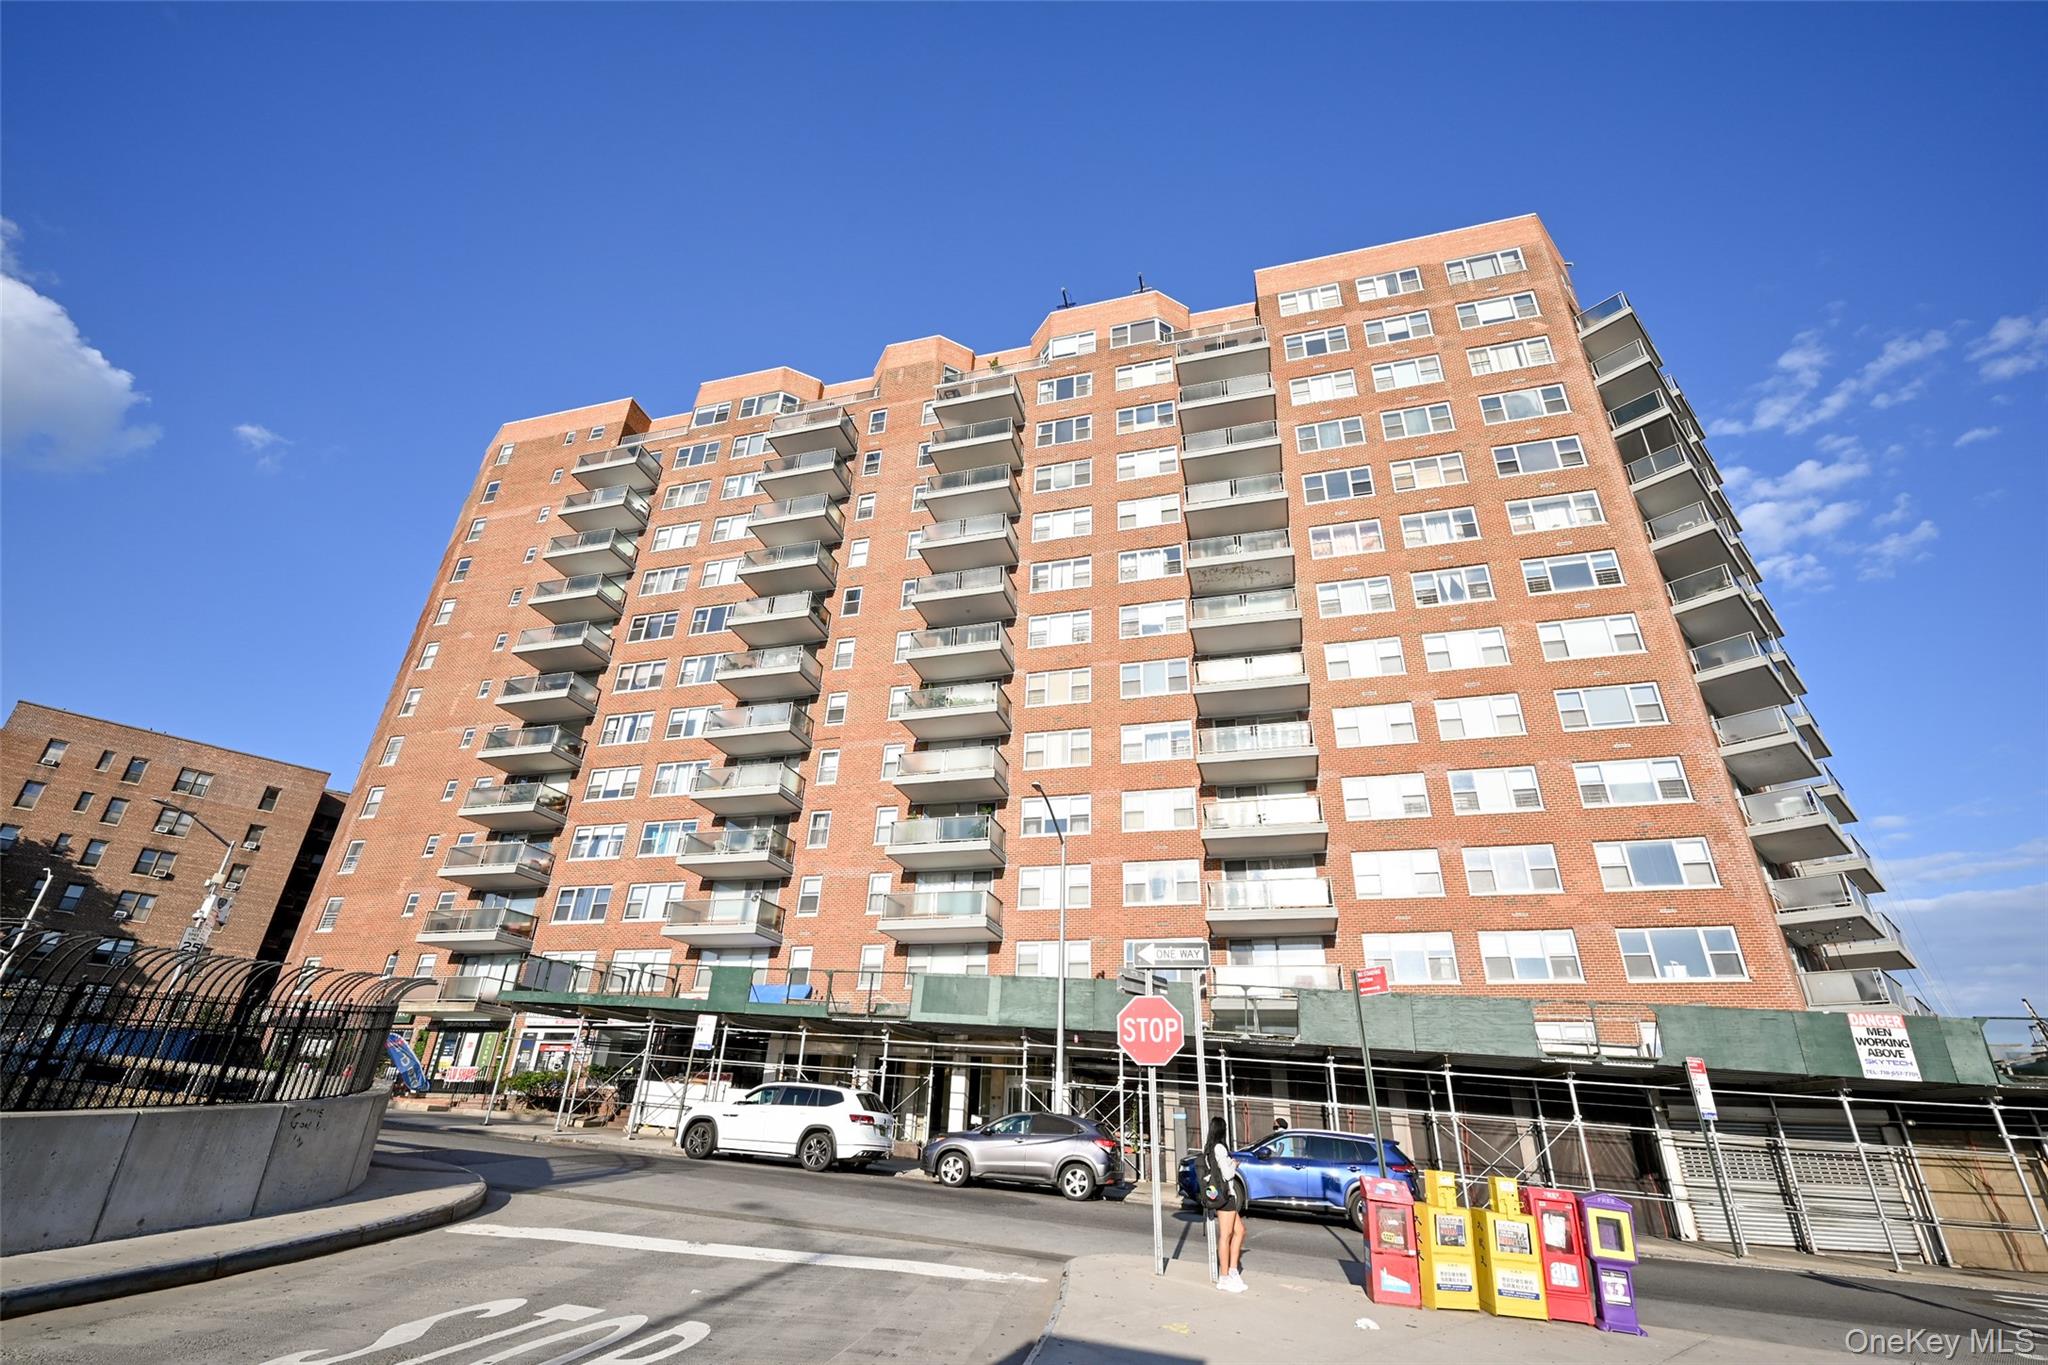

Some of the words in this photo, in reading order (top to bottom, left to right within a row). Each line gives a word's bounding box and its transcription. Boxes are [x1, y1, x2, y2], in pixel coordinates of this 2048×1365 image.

[182, 941, 203, 953] 25
[1156, 949, 1177, 959] ONE
[1180, 949, 1200, 959] WAY
[1848, 1013, 1903, 1028] DANGER
[1123, 1017, 1179, 1043] STOP
[1866, 1027, 1892, 1037] MEN
[1855, 1037, 1910, 1048] WORKING
[1868, 1048, 1906, 1059] ABOVE
[1865, 1058, 1914, 1067] SKYTECH
[1597, 1197, 1616, 1205] FREE
